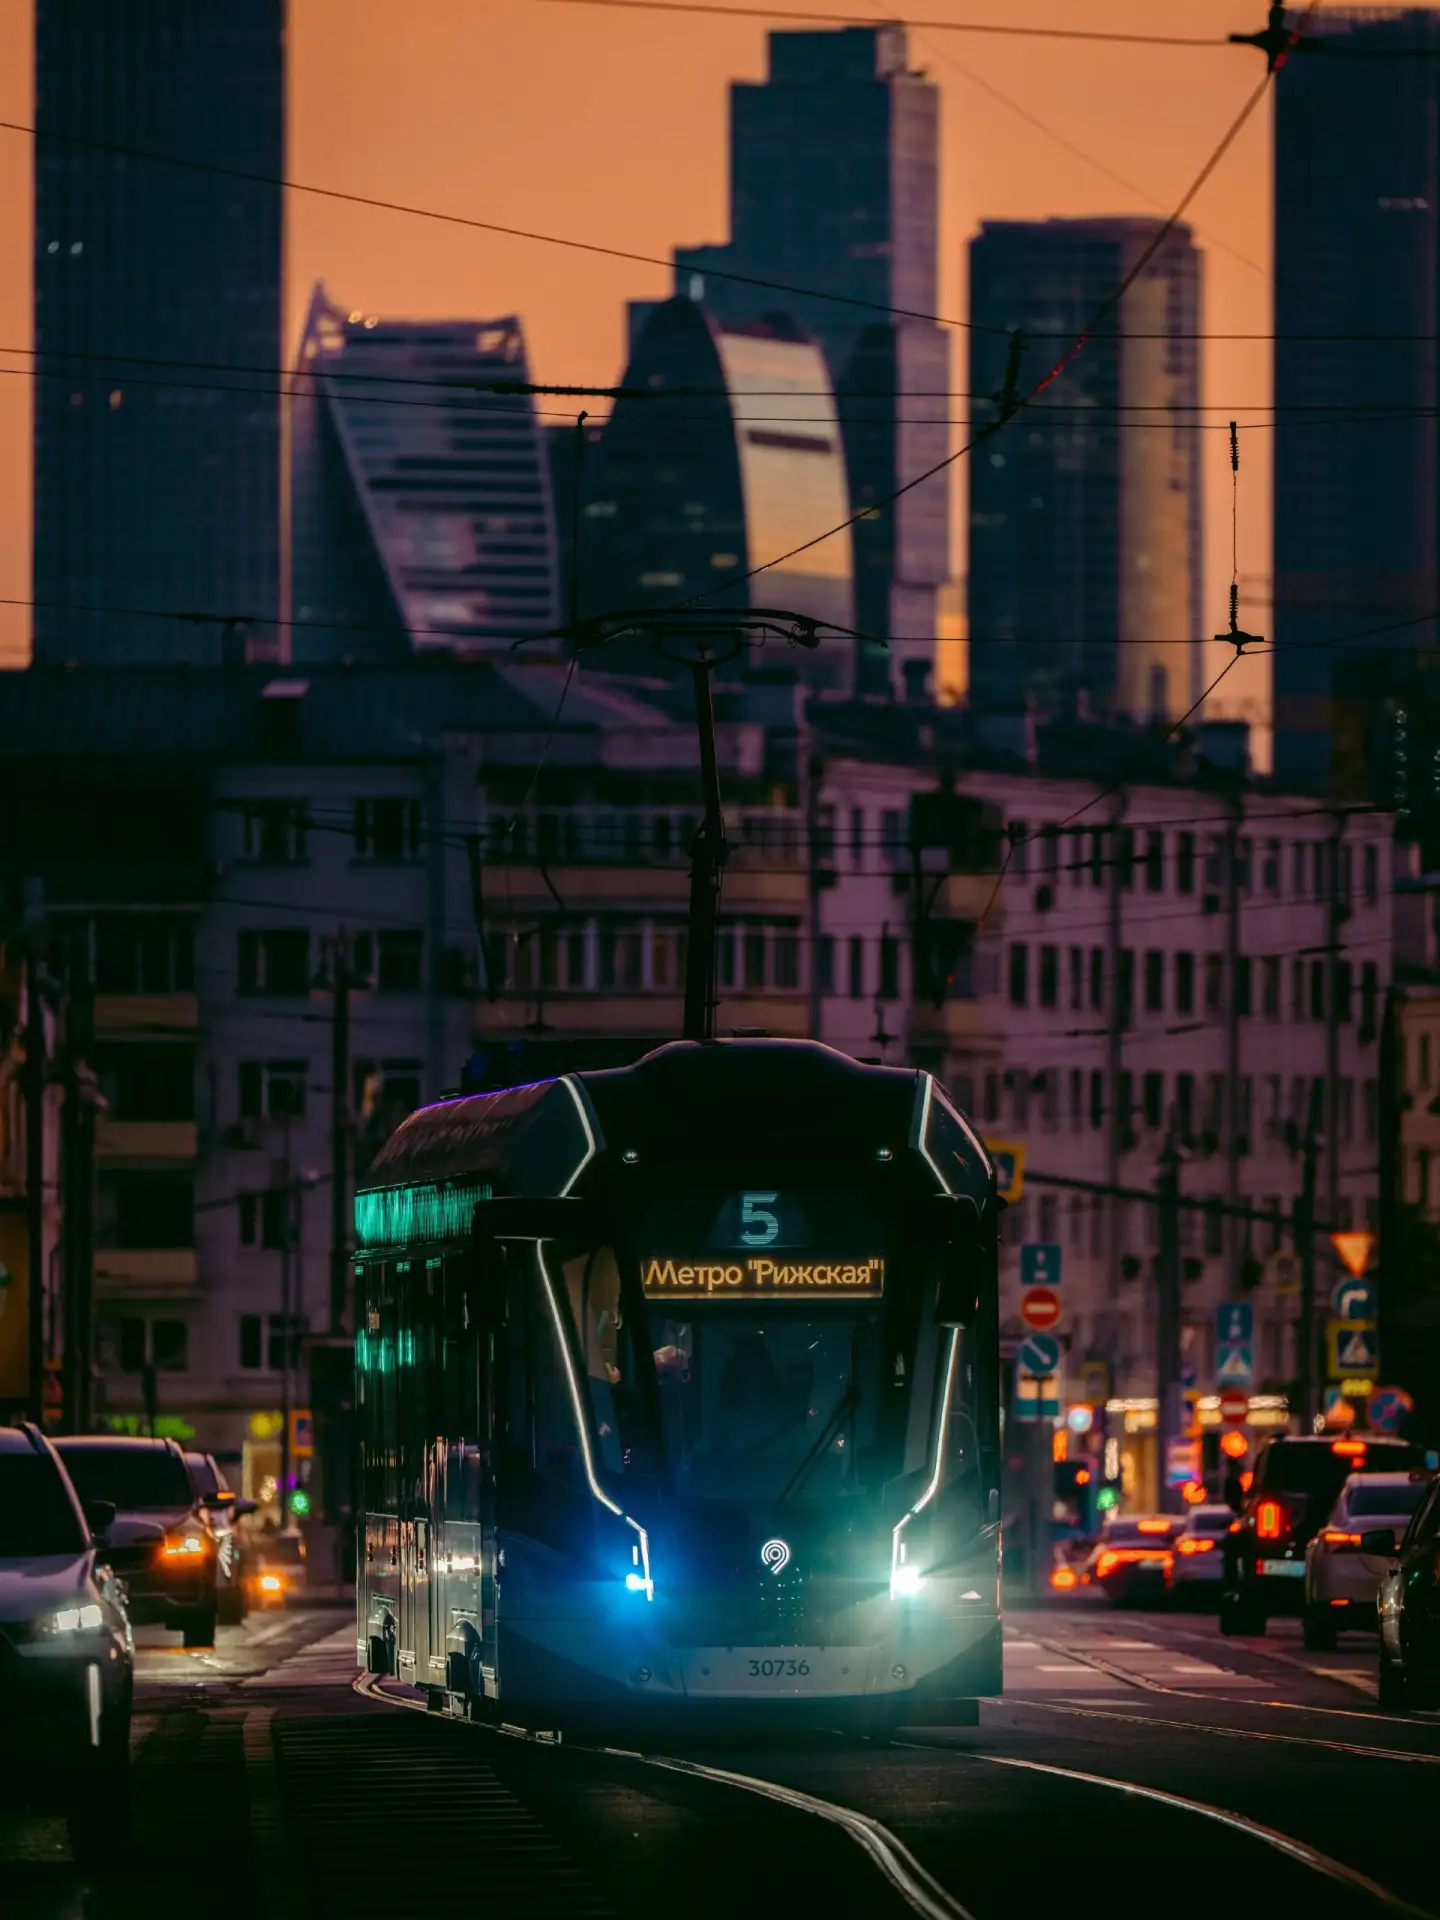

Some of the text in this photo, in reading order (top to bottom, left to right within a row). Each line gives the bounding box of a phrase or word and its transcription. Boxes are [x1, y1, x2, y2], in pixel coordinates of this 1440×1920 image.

[741, 1192, 779, 1245] 5
[645, 1259, 879, 1290] Метро "Рижская"
[748, 1659, 810, 1677] 30736
